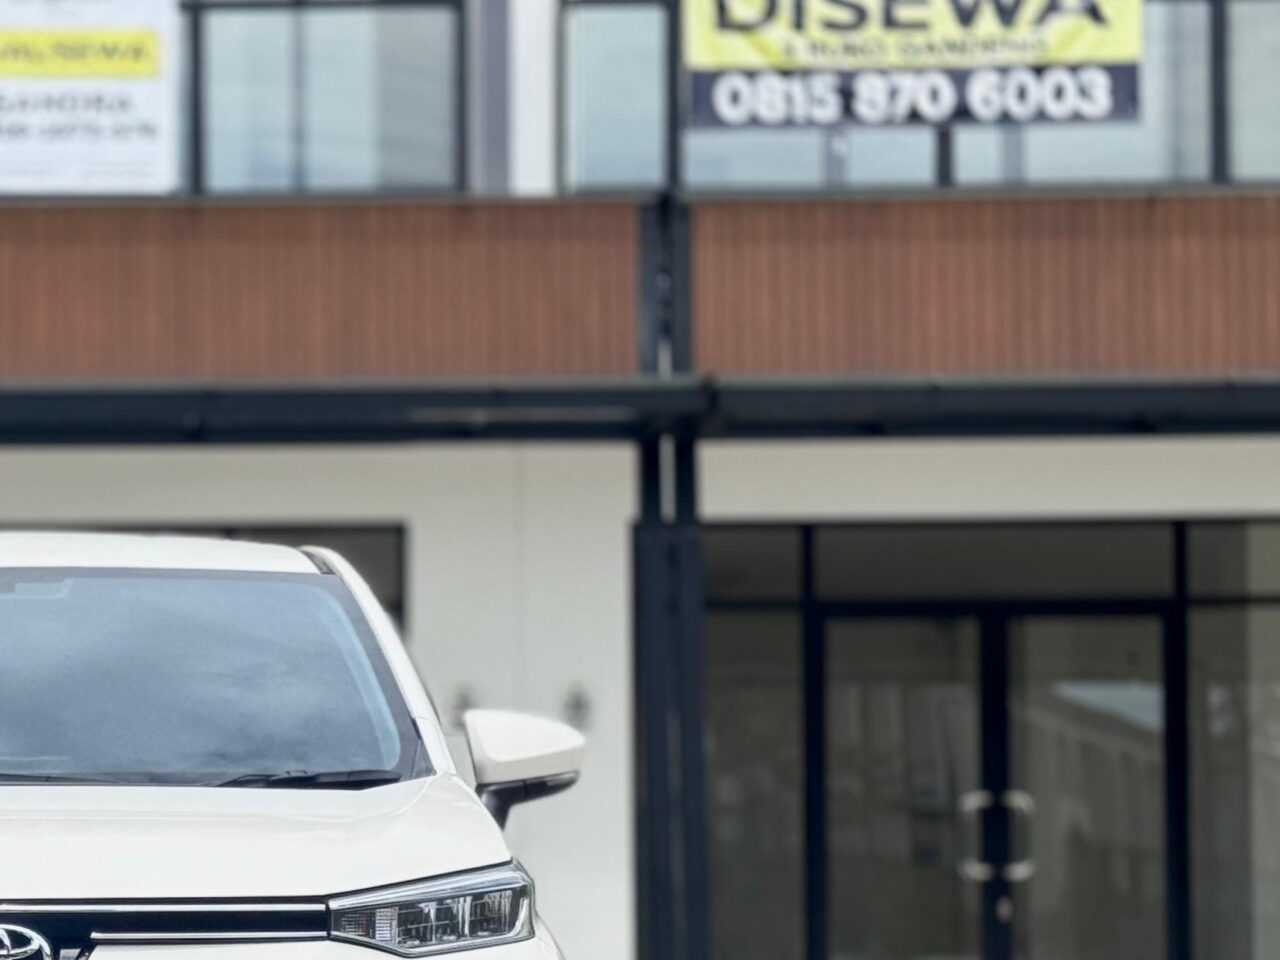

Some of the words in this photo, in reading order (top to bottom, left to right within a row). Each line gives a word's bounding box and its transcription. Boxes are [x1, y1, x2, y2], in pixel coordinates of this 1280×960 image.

[713, 70, 842, 125] 0815
[851, 70, 956, 124] 870
[966, 66, 1112, 121] 6003
